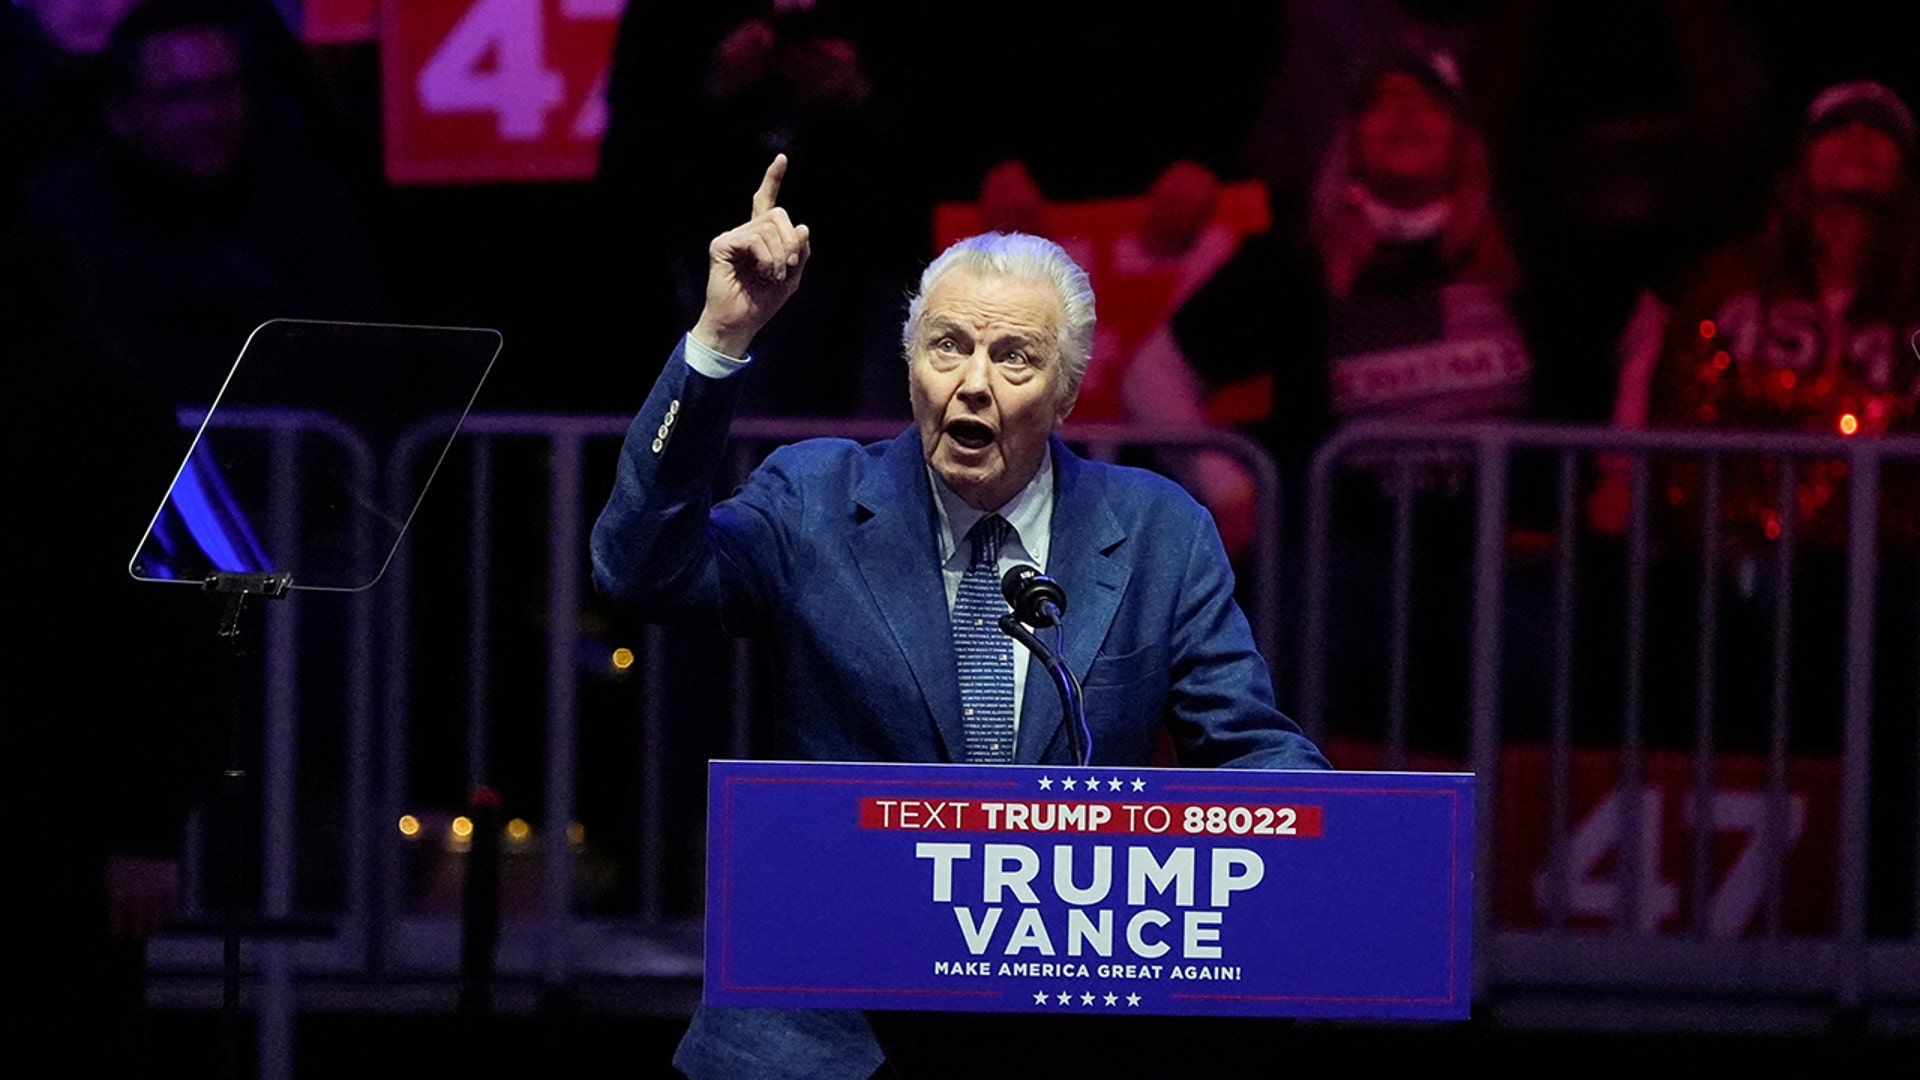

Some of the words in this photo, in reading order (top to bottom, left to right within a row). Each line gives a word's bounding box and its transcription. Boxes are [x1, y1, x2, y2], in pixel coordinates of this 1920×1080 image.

[876, 800, 970, 829] TEXT
[980, 802, 1112, 832] TRUMP
[1122, 805, 1171, 833] TO
[1183, 806, 1297, 835] 88022
[915, 842, 1265, 908] TRUMP
[1531, 784, 1808, 938] 47
[953, 906, 1223, 959] VANCE
[934, 961, 991, 976] MAKE
[998, 962, 1090, 978] AMERICA
[1097, 964, 1163, 979] GREAT
[1169, 965, 1241, 981] AGAIN!
